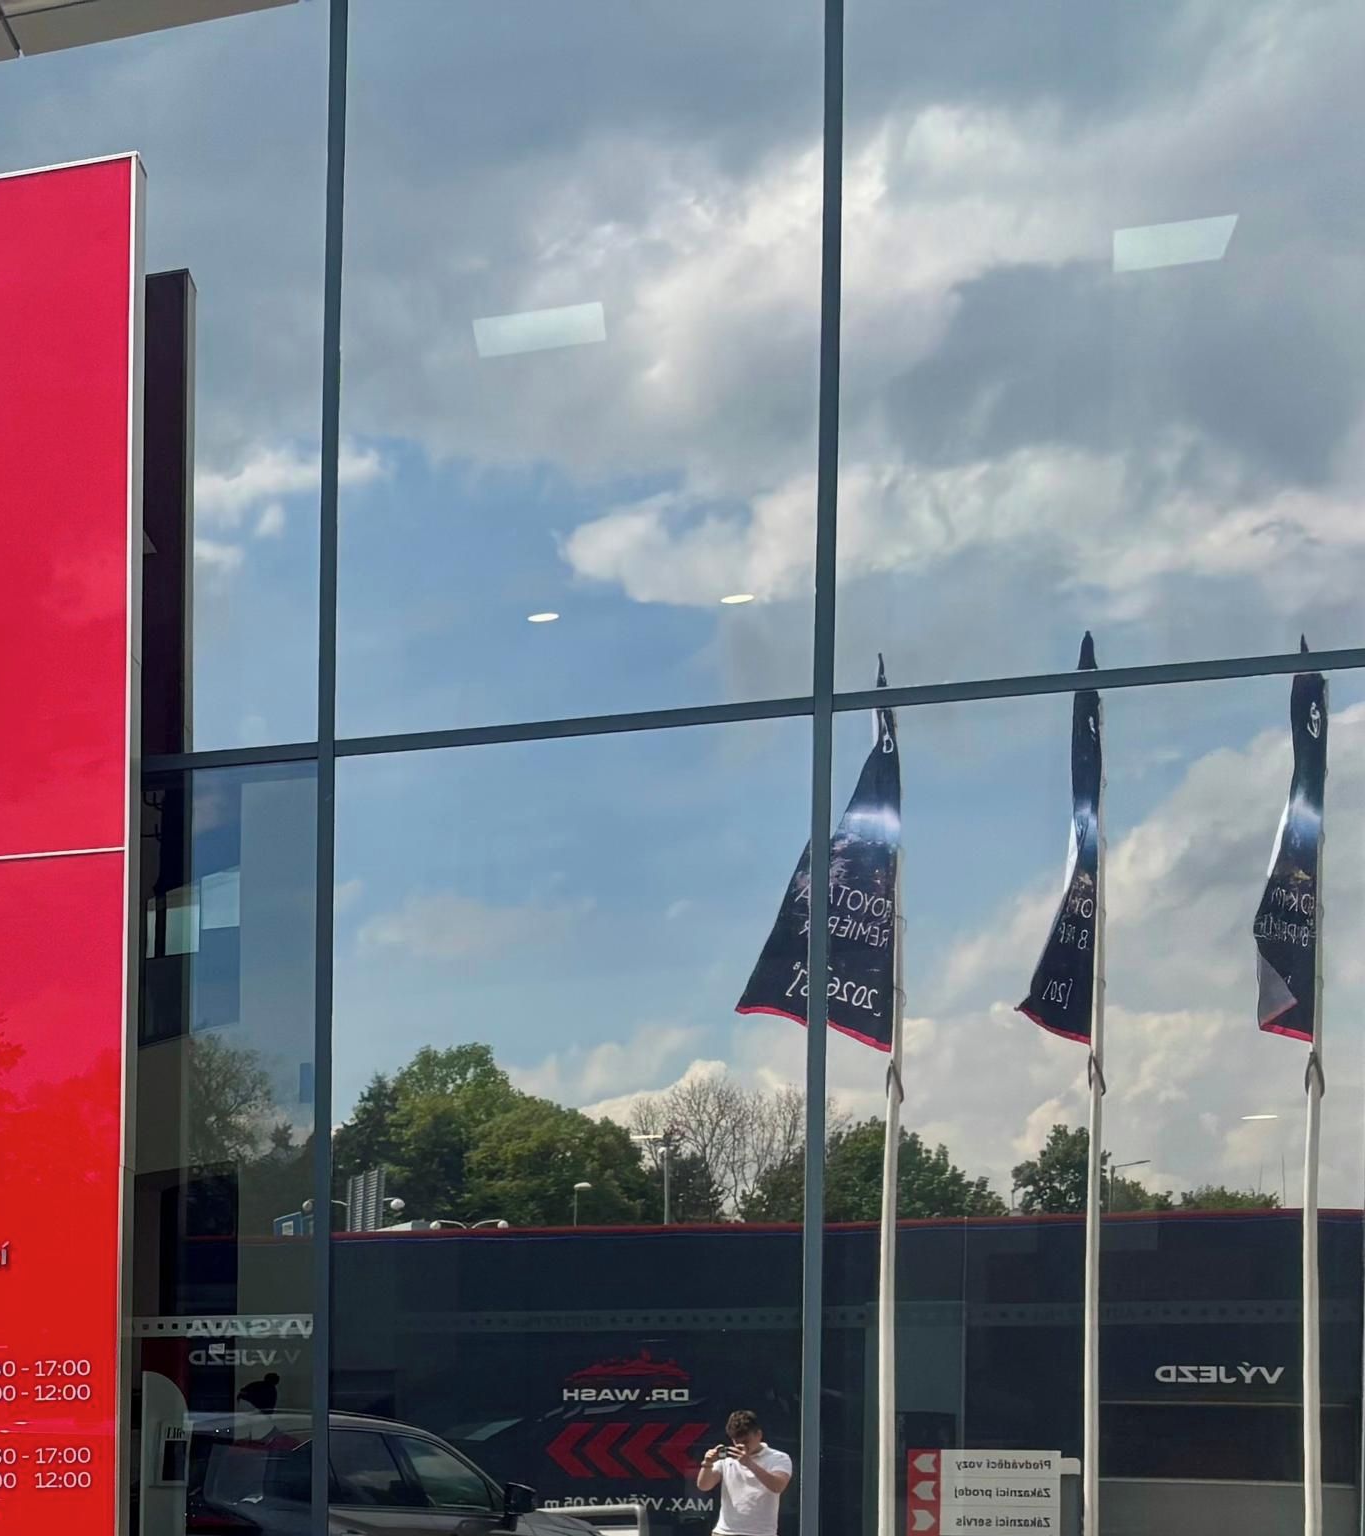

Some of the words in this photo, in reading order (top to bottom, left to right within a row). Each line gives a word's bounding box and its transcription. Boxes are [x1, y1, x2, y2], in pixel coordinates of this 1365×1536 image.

[34, 1359, 91, 1377] 17:00
[34, 1384, 91, 1401] 12:00
[35, 1447, 91, 1464] 17:00
[34, 1471, 91, 1489] 12:00
